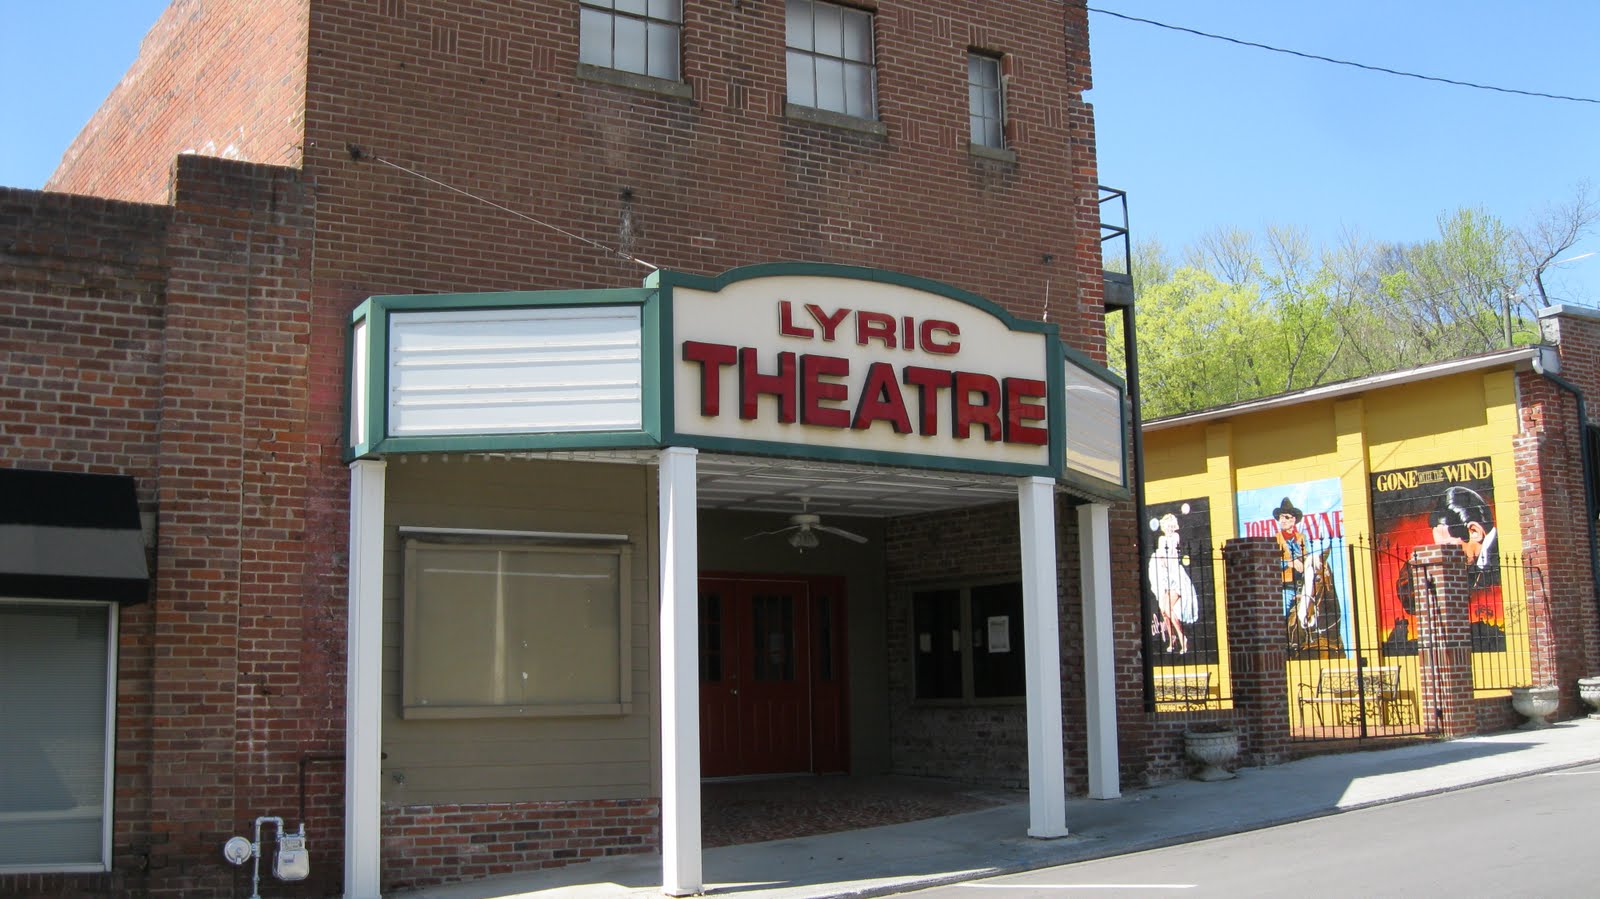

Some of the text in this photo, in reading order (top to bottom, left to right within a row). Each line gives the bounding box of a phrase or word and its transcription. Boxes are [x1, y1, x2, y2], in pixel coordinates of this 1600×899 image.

[778, 301, 961, 355] LYRIC
[682, 340, 1048, 446] THEATRE
[1376, 470, 1419, 491] GONE
[1442, 460, 1492, 483] WIND
[1299, 510, 1344, 540] AYNE
